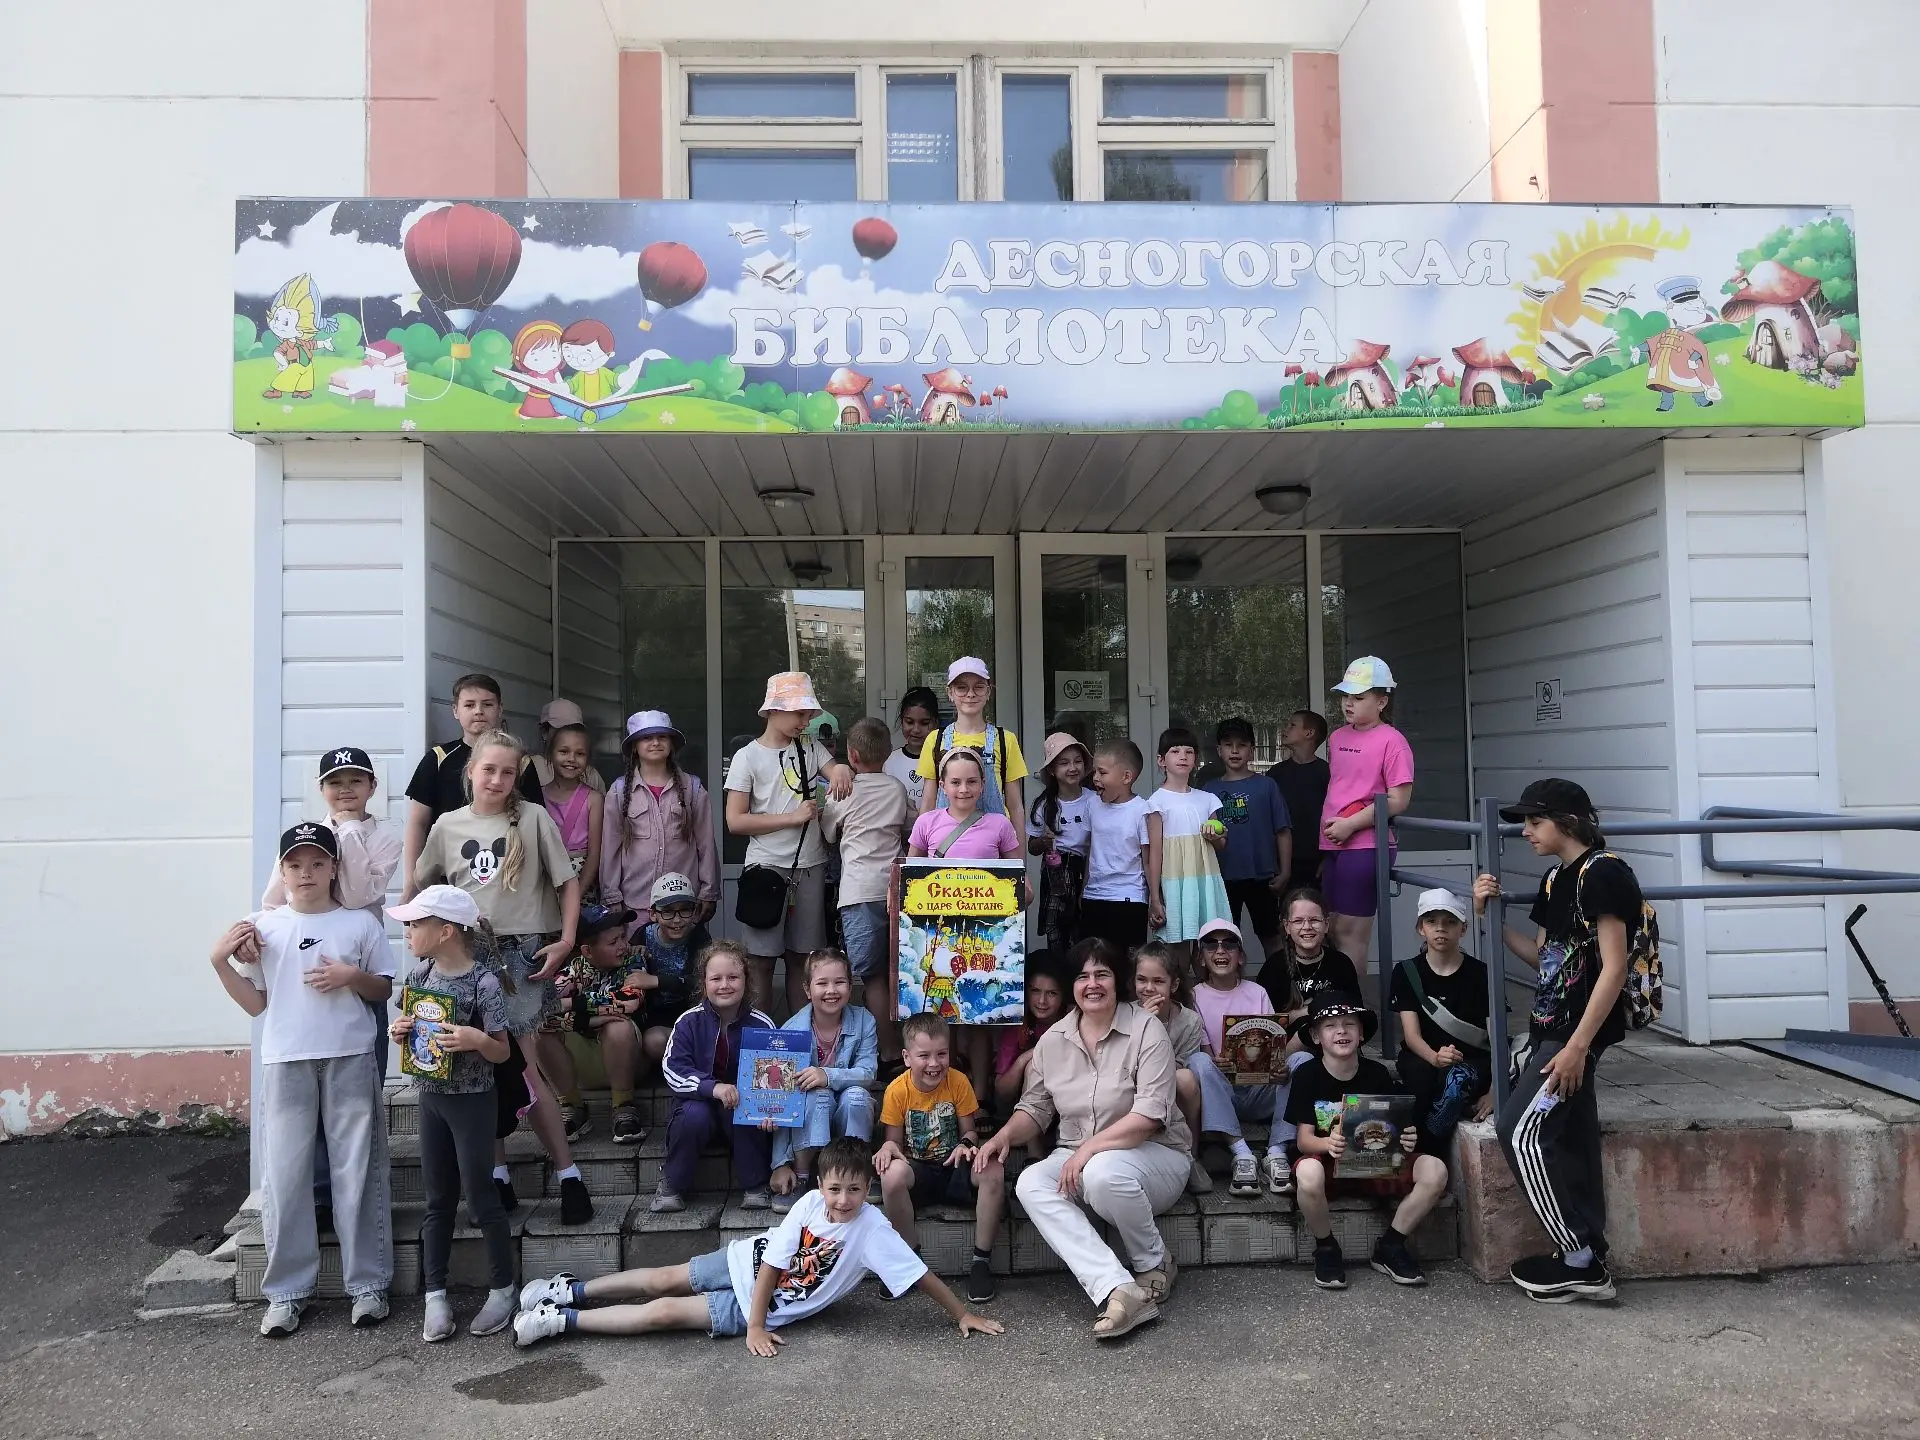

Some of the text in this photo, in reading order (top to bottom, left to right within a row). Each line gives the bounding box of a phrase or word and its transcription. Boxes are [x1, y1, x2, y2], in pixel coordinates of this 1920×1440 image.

[935, 239, 1510, 293] ДЕСНОГОРСКАЯ
[729, 306, 1346, 366] БИБЛИОТЕКА
[927, 882, 995, 899] Сказка
